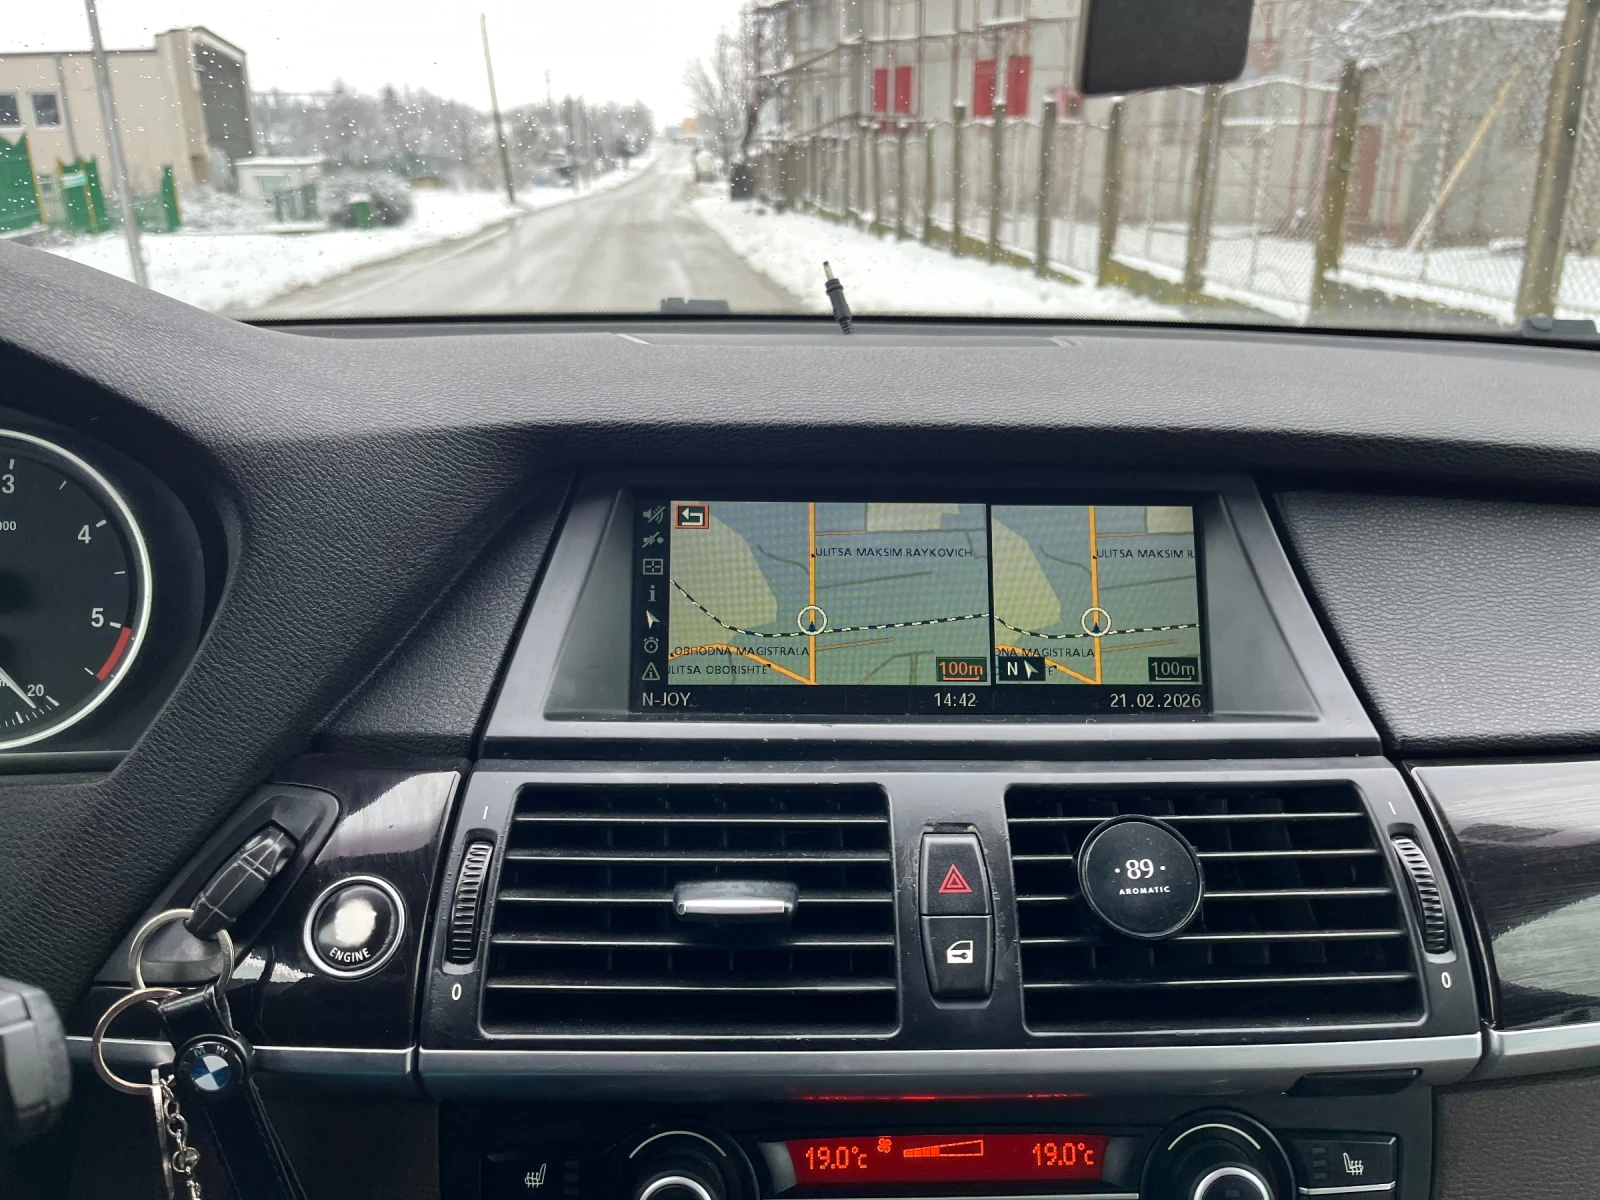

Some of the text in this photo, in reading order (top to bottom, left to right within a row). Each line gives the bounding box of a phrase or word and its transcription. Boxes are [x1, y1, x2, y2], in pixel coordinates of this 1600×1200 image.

[1, 473, 15, 494] 3
[77, 524, 92, 544] 4
[815, 547, 973, 558] ULITSA MAKSIM RAYKOVICH
[1096, 549, 1134, 559] ULITSA
[1137, 549, 1184, 559] MAKSIM
[91, 607, 105, 628] 5
[736, 646, 810, 656] MAGISTRALA
[1021, 647, 1096, 658] MAGISTRALA
[705, 665, 768, 675] OBORISHTE
[939, 661, 983, 676] 100m
[1007, 661, 1019, 676] N
[1151, 661, 1195, 676] 100m
[27, 683, 45, 697] 20
[642, 691, 691, 707] N-JOY
[933, 692, 977, 707] 14:42
[1110, 693, 1202, 708] 21.02.2026
[1125, 858, 1155, 880] 89
[1119, 885, 1171, 896] AROMATIC
[329, 946, 371, 963] ENGINE
